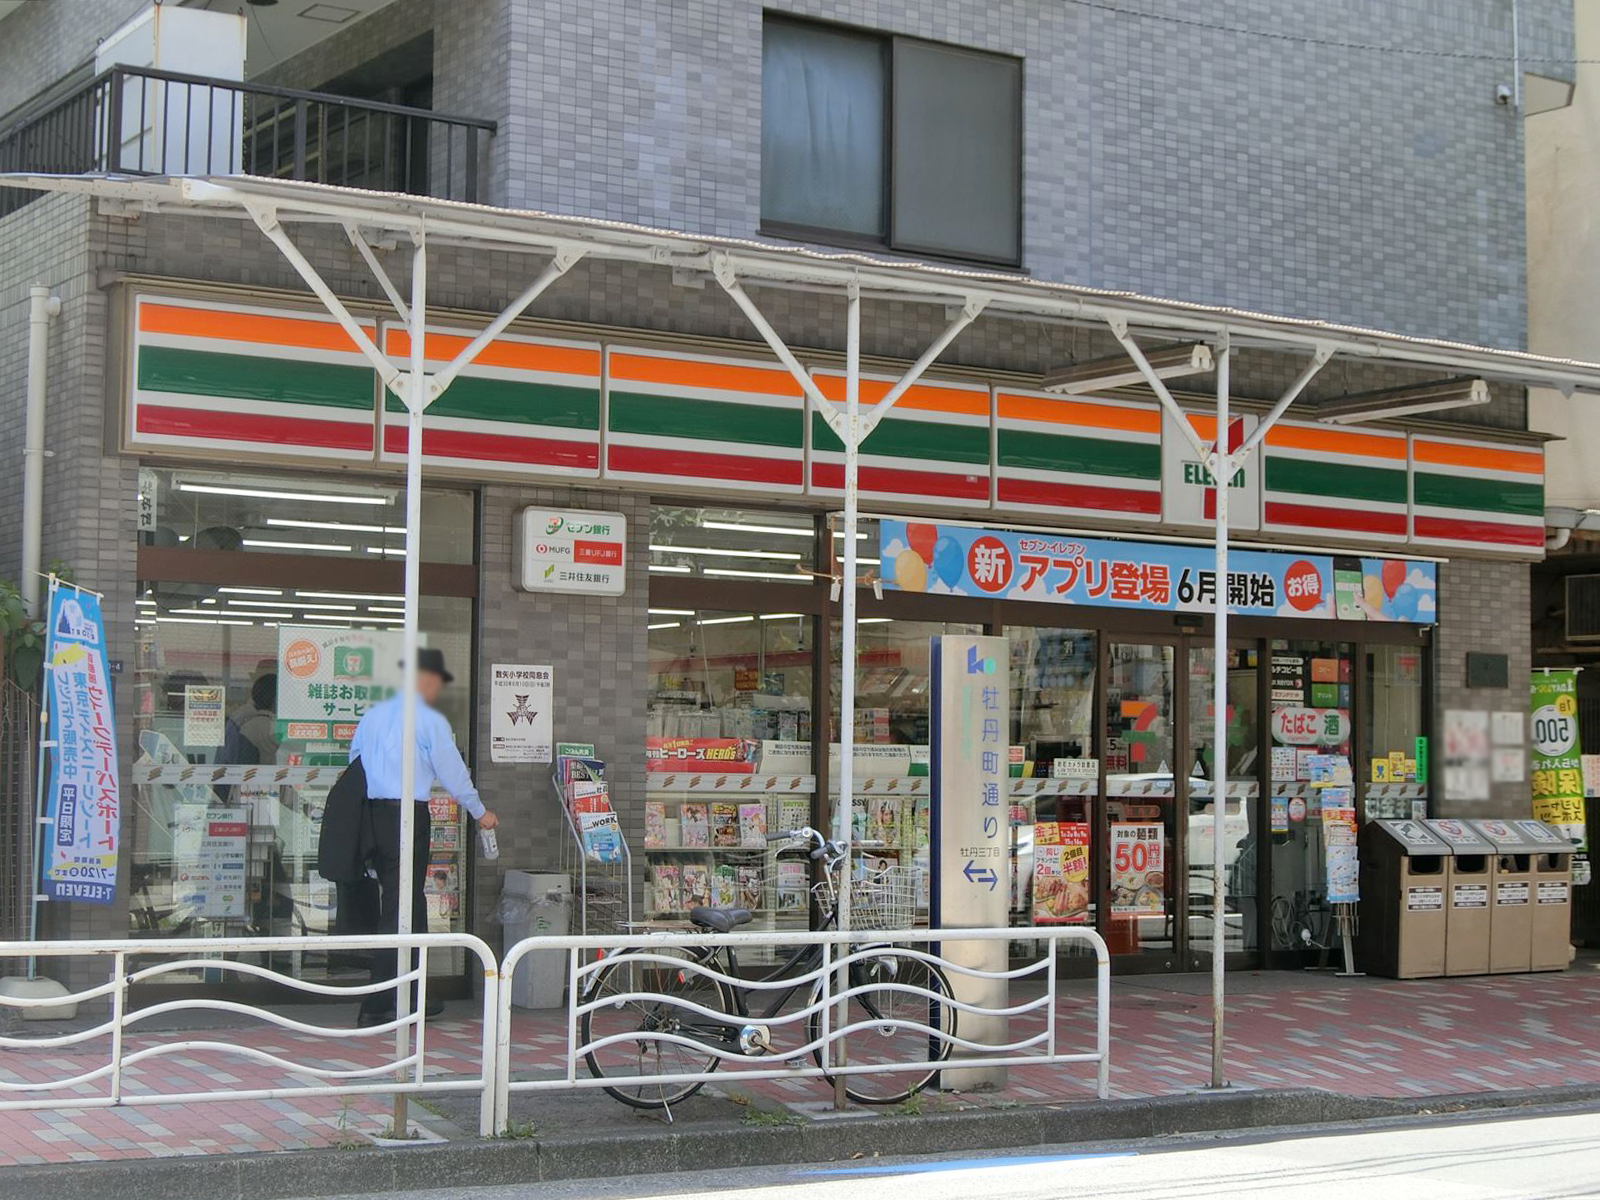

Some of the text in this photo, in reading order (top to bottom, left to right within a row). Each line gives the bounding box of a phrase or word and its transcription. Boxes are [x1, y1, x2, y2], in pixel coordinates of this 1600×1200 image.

[1184, 463, 1246, 488] ELEn
[566, 523, 610, 536] セブン銀行
[548, 546, 571, 555] MUFG
[579, 548, 617, 558] 三菱UFJ銀行
[974, 543, 1005, 585] 新
[559, 571, 610, 584] 三井住友銀行
[1019, 554, 1275, 608] アプリ登場 6月開始
[1286, 572, 1320, 598] お得
[1281, 713, 1340, 735] たばこ 酒
[981, 686, 1000, 839] 牡丹町通り
[592, 816, 617, 828] WORK
[960, 847, 1000, 857] 牡丹三丁目
